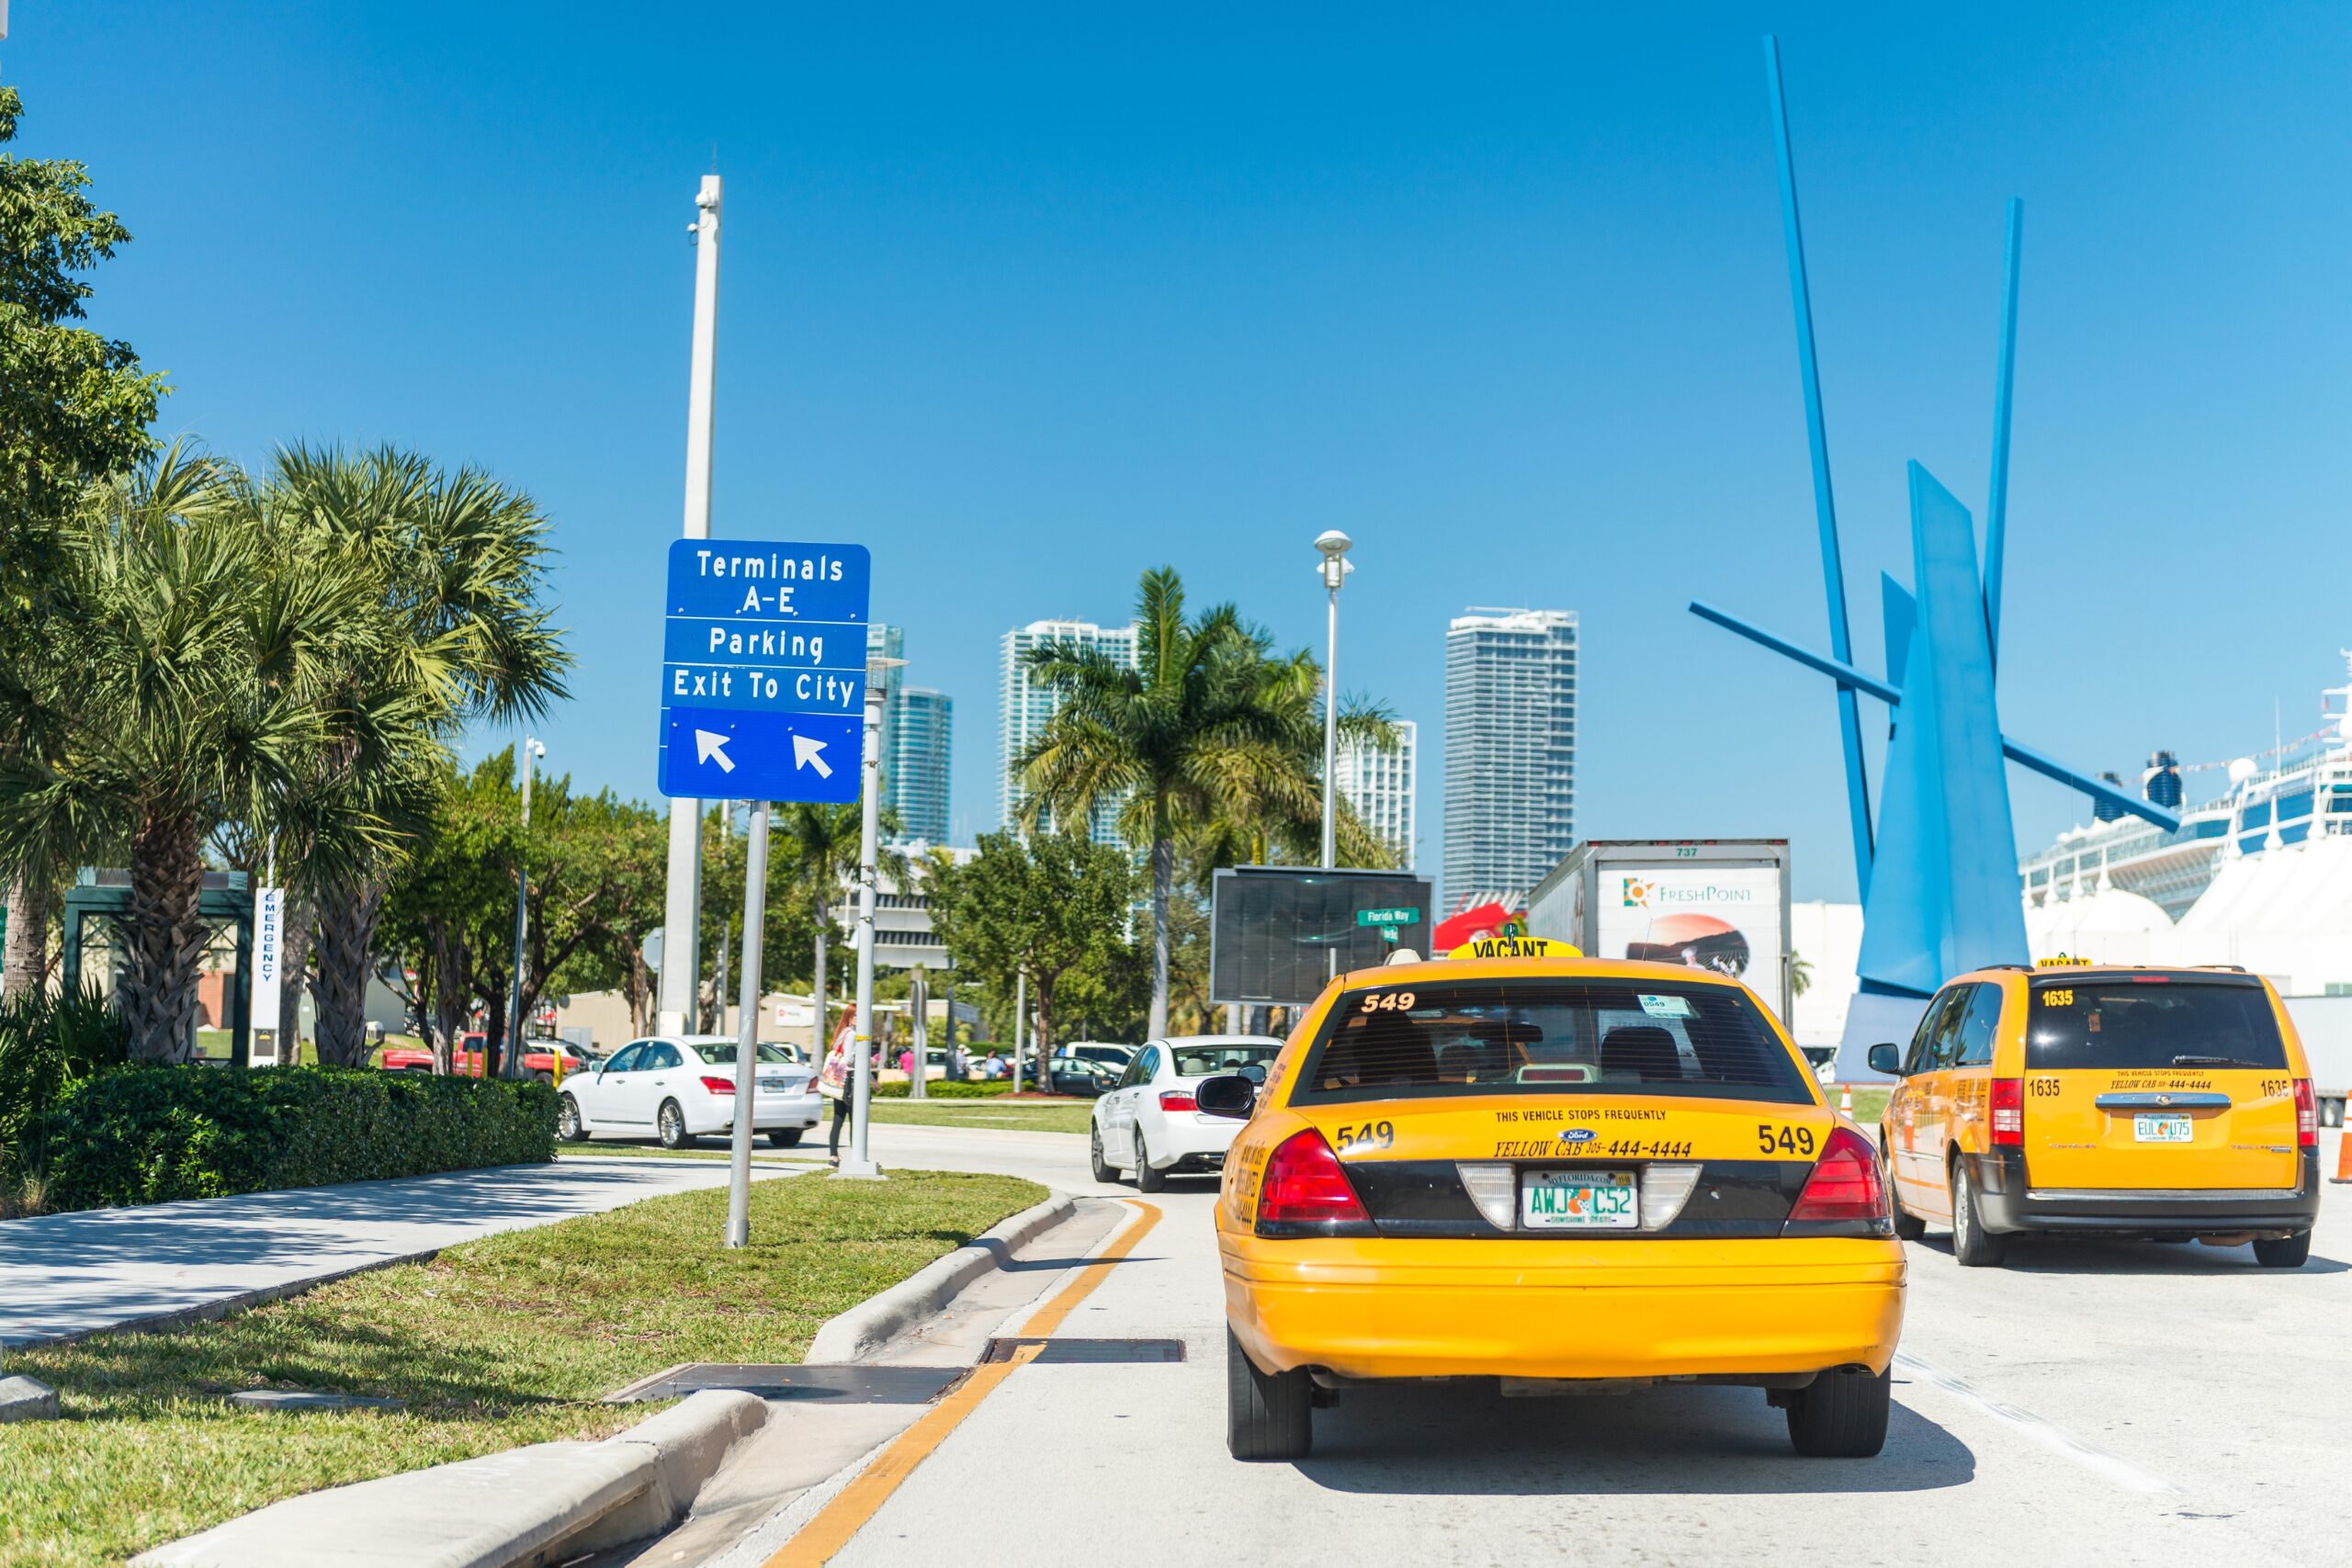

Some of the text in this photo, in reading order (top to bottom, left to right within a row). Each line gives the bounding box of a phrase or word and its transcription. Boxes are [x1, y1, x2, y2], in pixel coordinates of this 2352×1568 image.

[696, 550, 843, 581] Terminals
[742, 585, 795, 613] A-E
[709, 627, 823, 666] Parking
[673, 669, 854, 708] Exit To City
[1676, 848, 1698, 857] 737
[1367, 910, 1409, 922] Florida Way
[263, 894, 276, 982] EMERGENCY
[1473, 940, 1548, 958] VACANT
[1361, 992, 1416, 1013] 549
[2042, 989, 2074, 1007] 1635
[2029, 1078, 2061, 1097] 1635
[2110, 1080, 2142, 1089] YELLOW
[2142, 1080, 2157, 1089] CAB
[2261, 1079, 2290, 1098] 1635
[1496, 1110, 1667, 1122] THIS VEHICLE STOPS FREQUENTLY
[1337, 1121, 1395, 1153] 549
[1567, 1131, 1589, 1139] Ford
[2138, 1122, 2190, 1136] EUL U75
[1493, 1140, 1554, 1157] YELLOW
[1555, 1140, 1584, 1156] CAB
[1758, 1124, 1815, 1156] 549
[1531, 1186, 1632, 1214] AWJ C52
